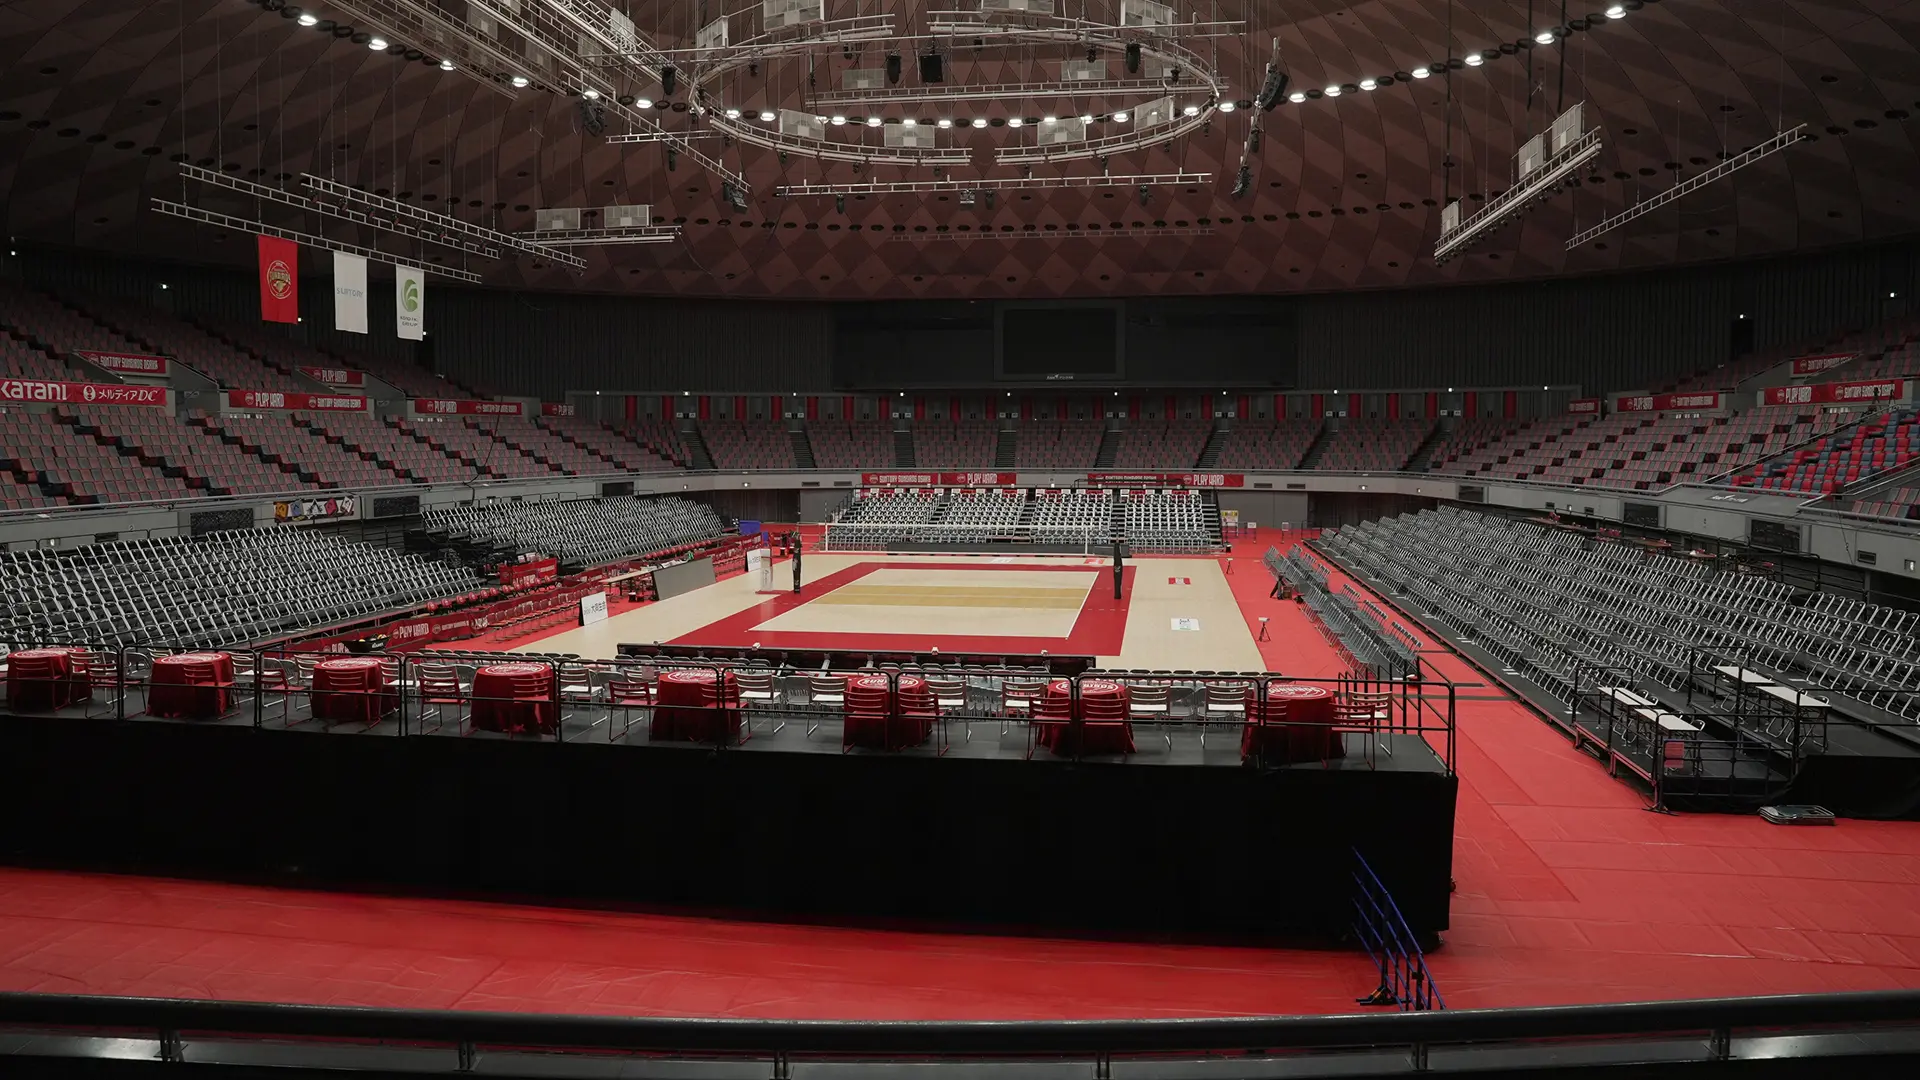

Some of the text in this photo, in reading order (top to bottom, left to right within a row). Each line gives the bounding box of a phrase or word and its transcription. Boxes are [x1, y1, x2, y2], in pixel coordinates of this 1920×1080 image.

[255, 392, 270, 407] PLAY
[879, 475, 931, 483] SUNTORY SUNBIRDS OSAKA
[967, 473, 997, 484] PLAY HARD
[1193, 474, 1224, 486] PLAY HARD
